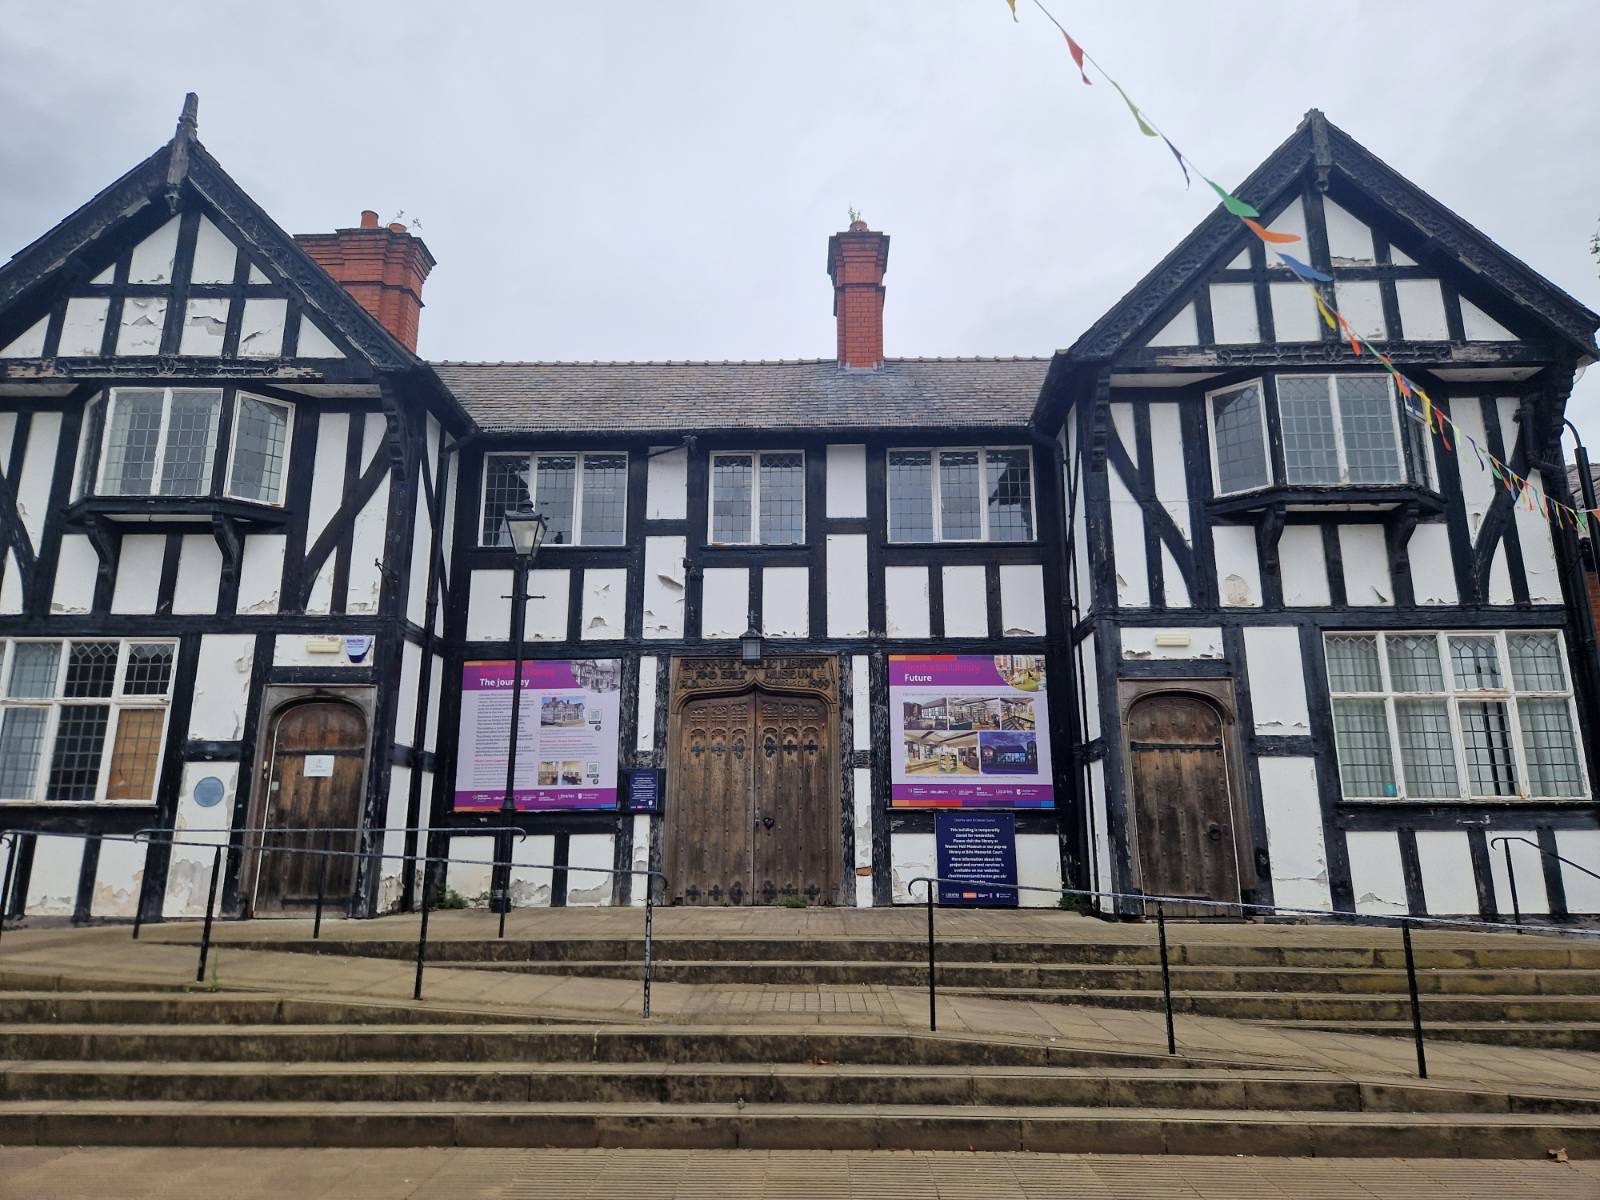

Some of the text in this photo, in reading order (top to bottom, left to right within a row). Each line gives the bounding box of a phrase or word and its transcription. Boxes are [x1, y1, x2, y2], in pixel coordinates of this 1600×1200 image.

[764, 669, 814, 679] MUSEUM
[904, 673, 932, 682] Future
[480, 678, 495, 686] The
